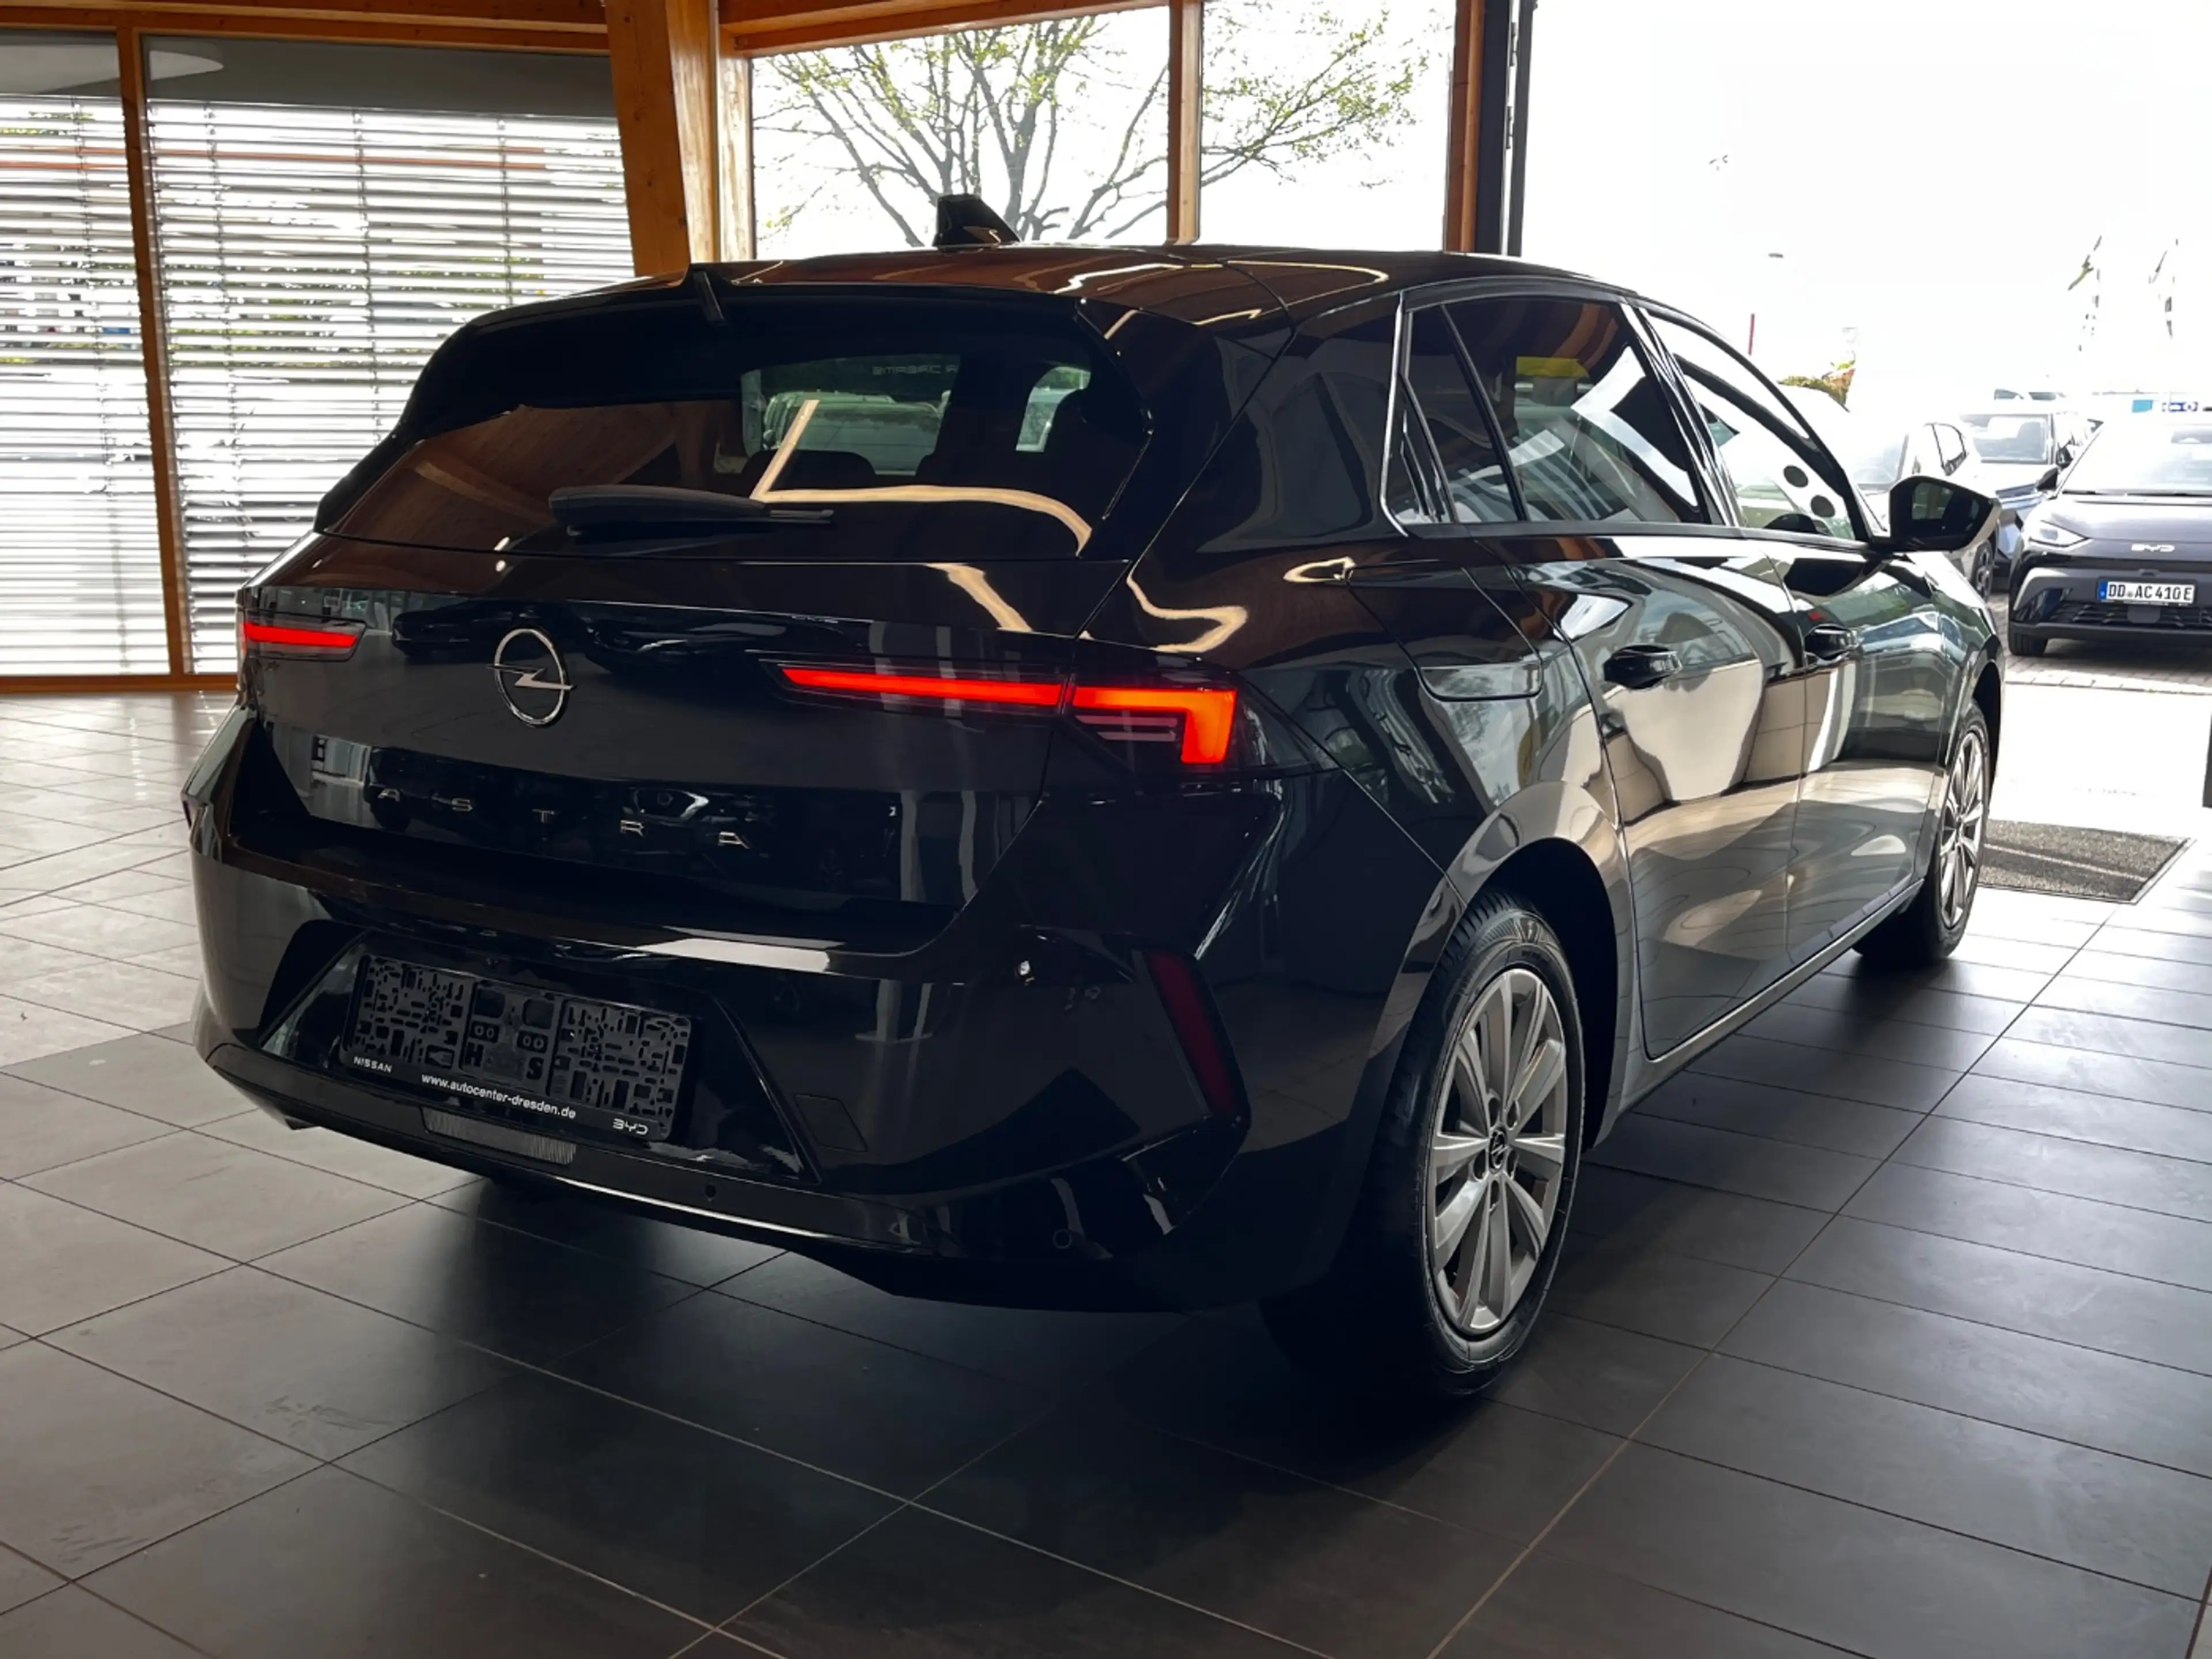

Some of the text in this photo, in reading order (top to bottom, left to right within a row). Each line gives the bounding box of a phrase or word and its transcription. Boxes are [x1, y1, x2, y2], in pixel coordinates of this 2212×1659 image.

[377, 787, 751, 849] ASTRA
[353, 1056, 393, 1073] NISSAN
[421, 1073, 577, 1119] www.autocenter-dresden.de
[612, 1118, 649, 1135] BYD
